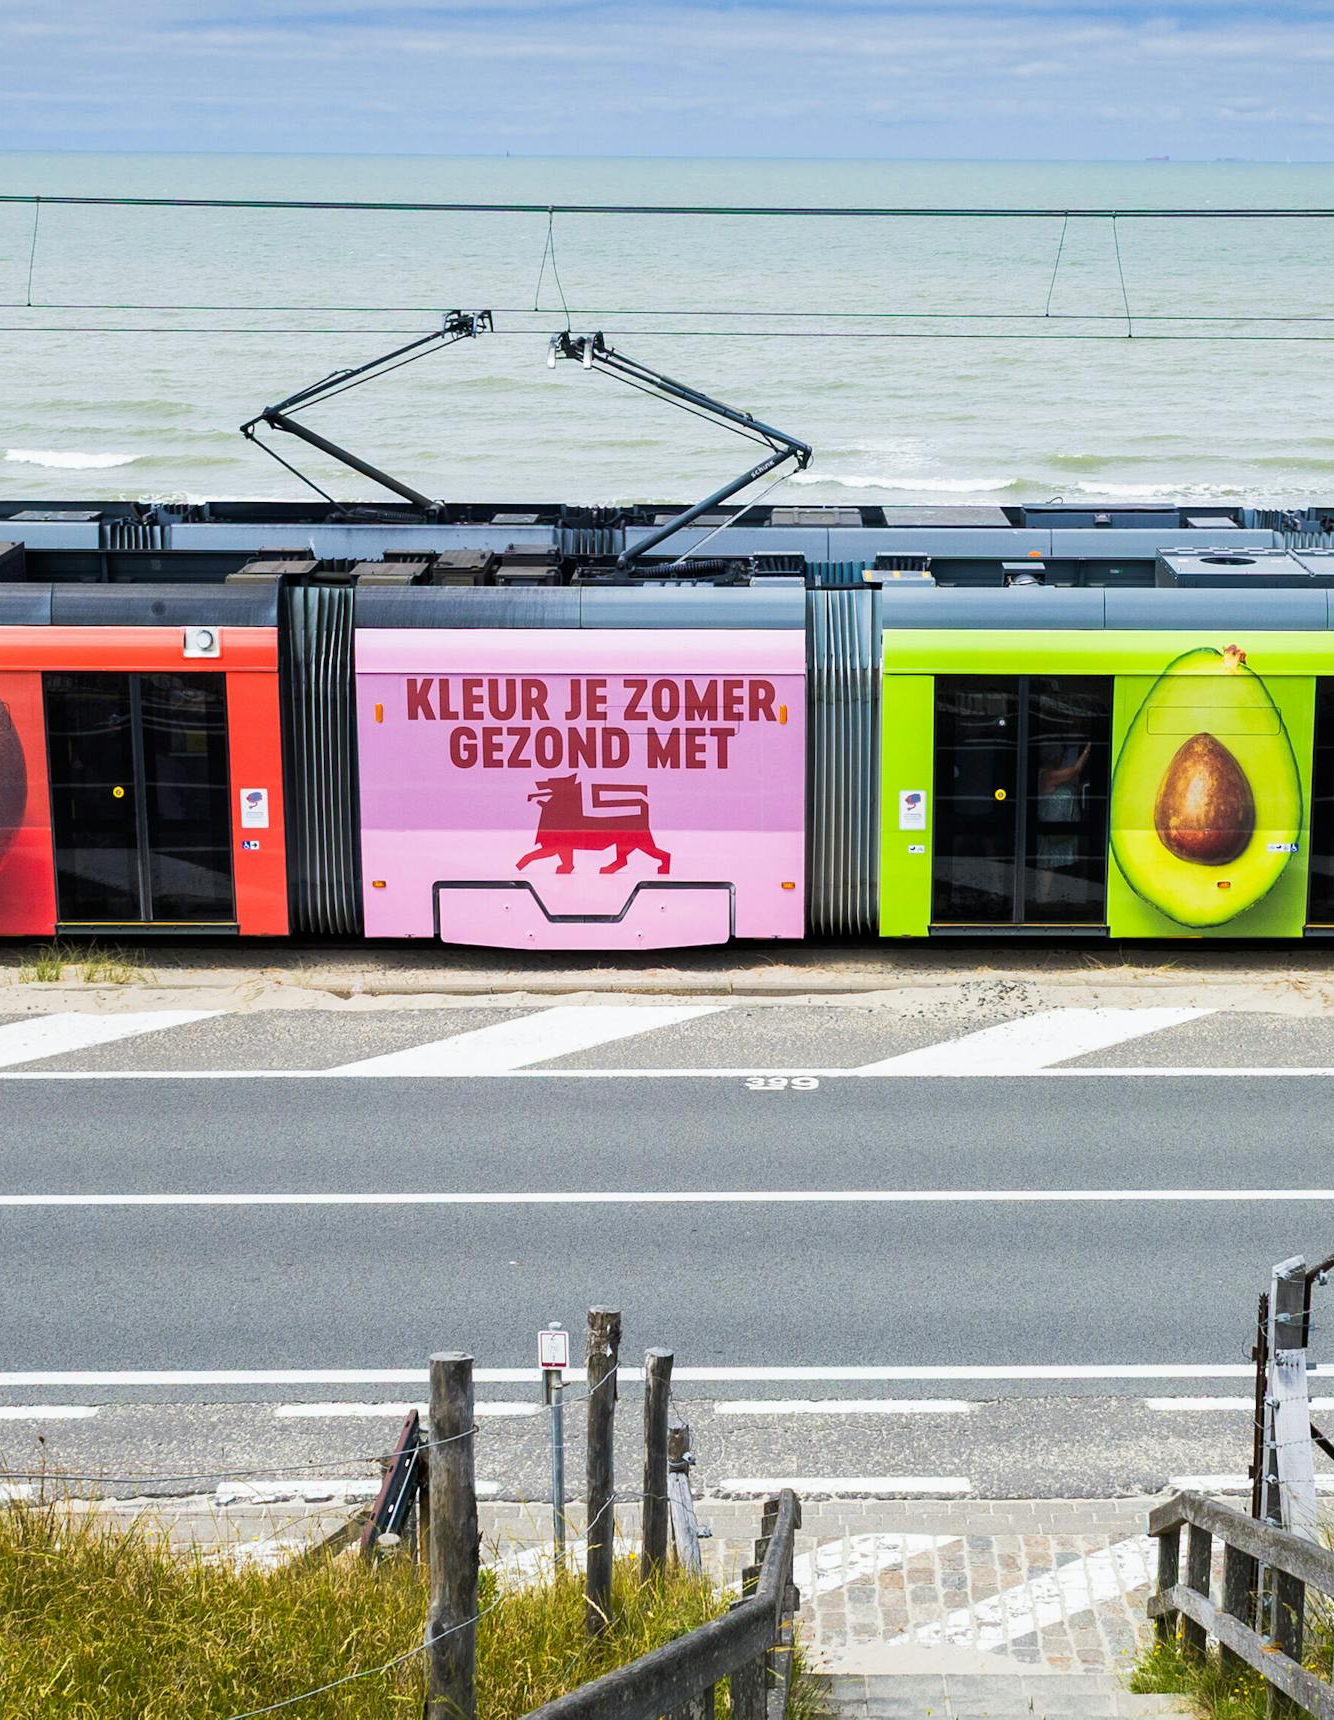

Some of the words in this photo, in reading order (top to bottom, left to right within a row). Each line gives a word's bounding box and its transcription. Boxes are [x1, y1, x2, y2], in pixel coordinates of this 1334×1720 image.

[406, 678, 550, 722] KLEUR
[565, 678, 608, 722] JE
[623, 678, 777, 722] ZOMER
[449, 726, 630, 770] GEZOND
[647, 727, 735, 770] MET
